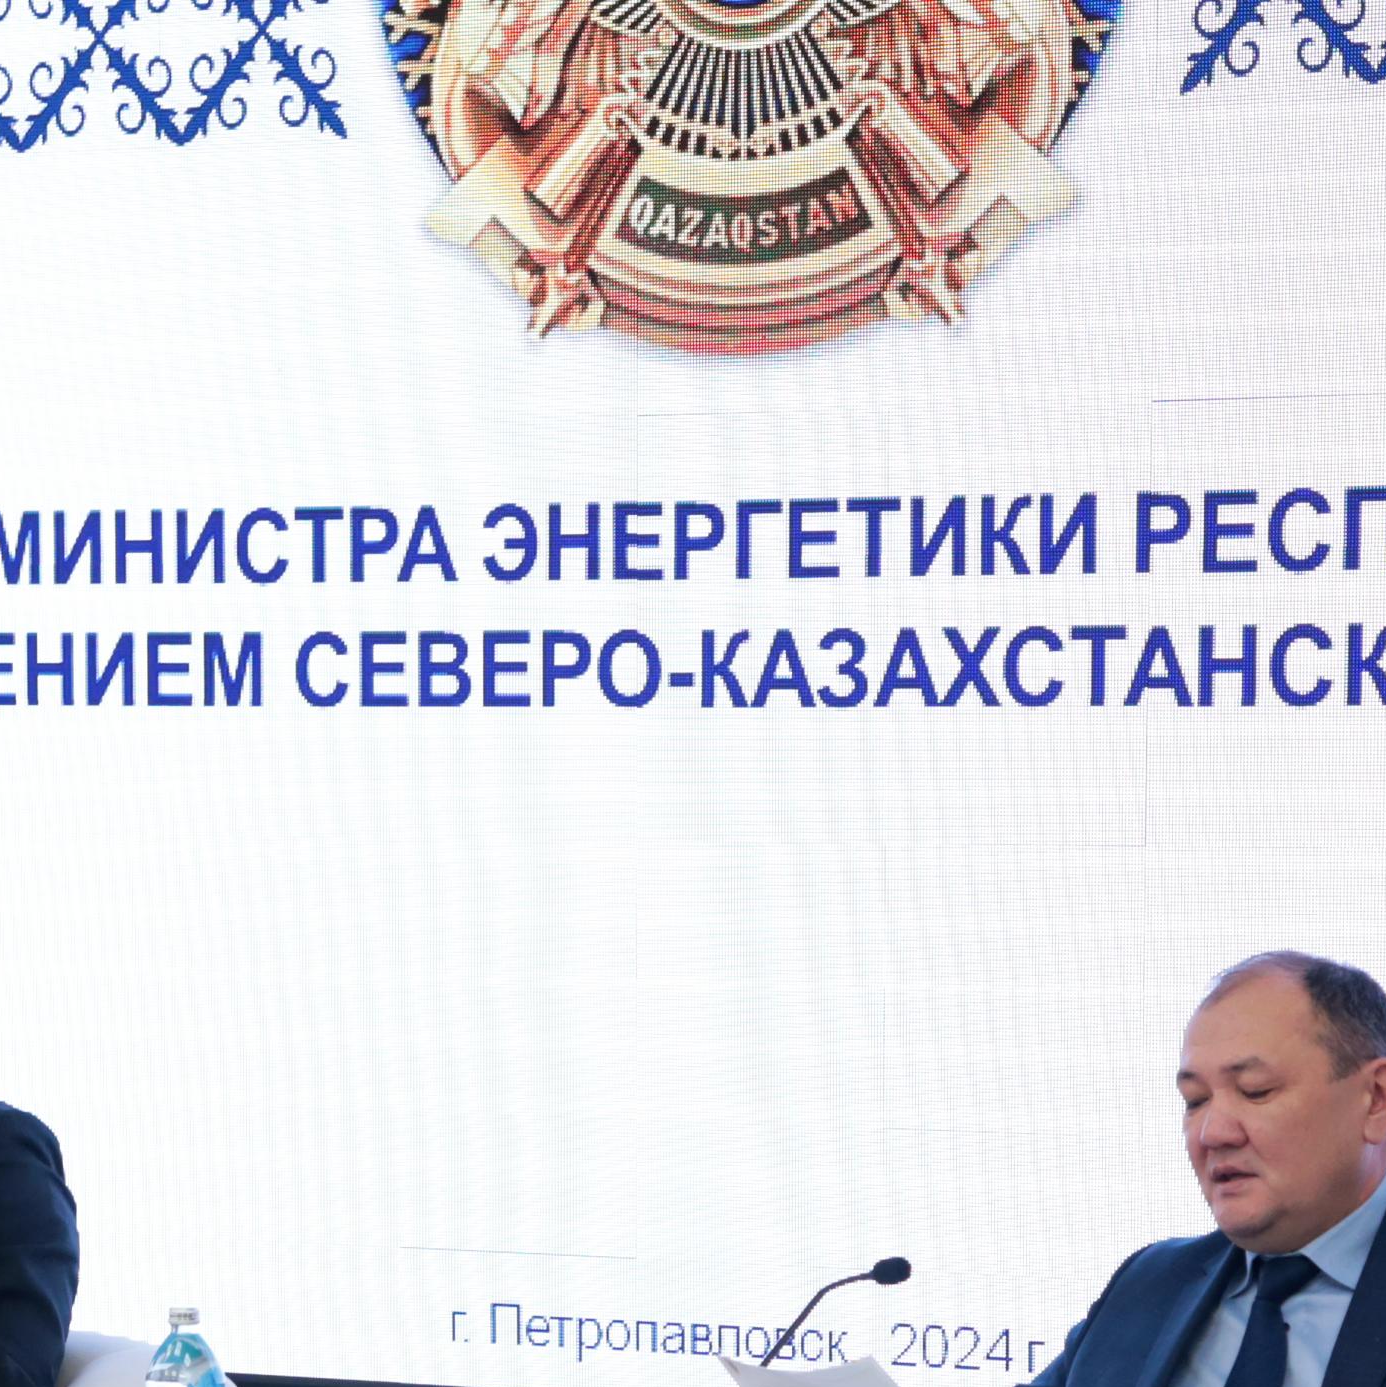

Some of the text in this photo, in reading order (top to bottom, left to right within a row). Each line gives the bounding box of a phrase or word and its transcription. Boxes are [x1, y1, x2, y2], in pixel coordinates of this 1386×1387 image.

[627, 188, 860, 254] QAZAQSTAN
[482, 493, 1097, 583] ЭНЕРГЕТИКИ
[451, 1310, 469, 1342] г.
[489, 1302, 849, 1364] Петропавловск
[891, 1322, 1013, 1372] 2024
